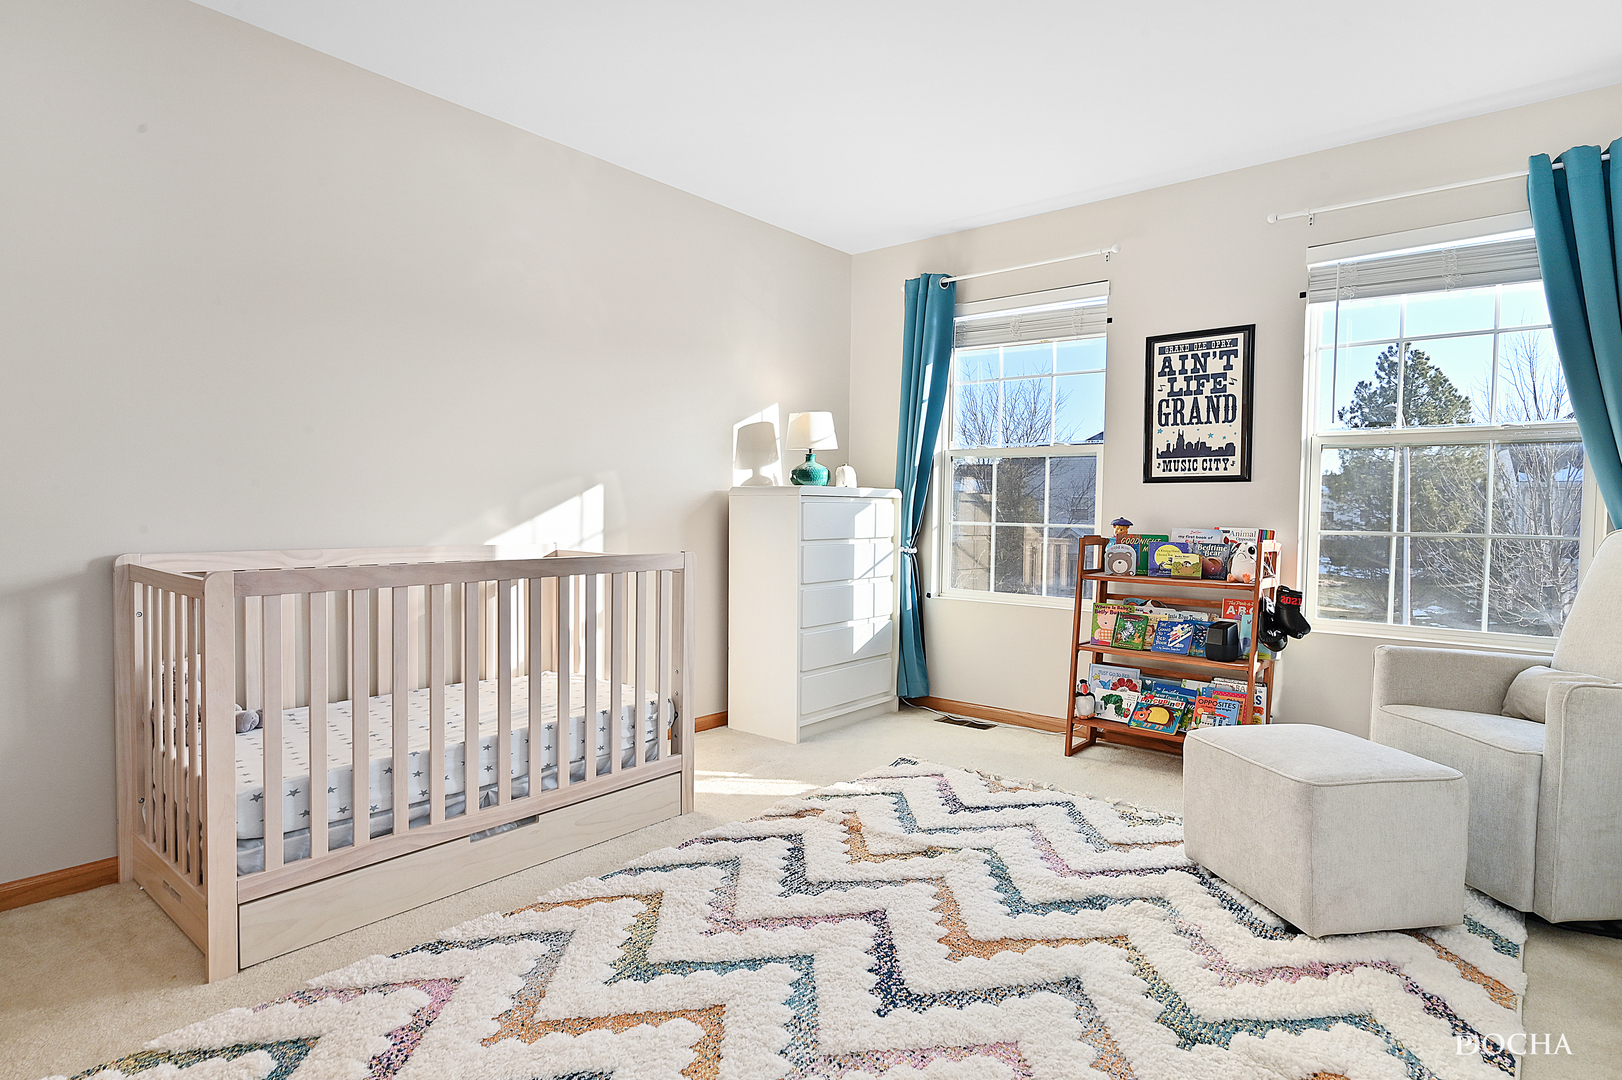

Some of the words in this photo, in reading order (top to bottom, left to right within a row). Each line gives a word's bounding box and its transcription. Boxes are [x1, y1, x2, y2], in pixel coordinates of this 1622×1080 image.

[1164, 344, 1190, 354] GRAND
[1194, 342, 1207, 350] OLE
[1212, 339, 1233, 349] OPRY.
[1158, 349, 1238, 378] AIN'T
[1167, 372, 1228, 398] LIFE
[1157, 394, 1237, 427] GRAND
[1162, 459, 1198, 472] MUSIC
[1202, 458, 1230, 472] CITY
[1197, 544, 1227, 552] Bedtime
[1280, 596, 1302, 606] 2021
[1140, 697, 1184, 708] porcupine!
[1198, 698, 1236, 709] OPPOSITES
